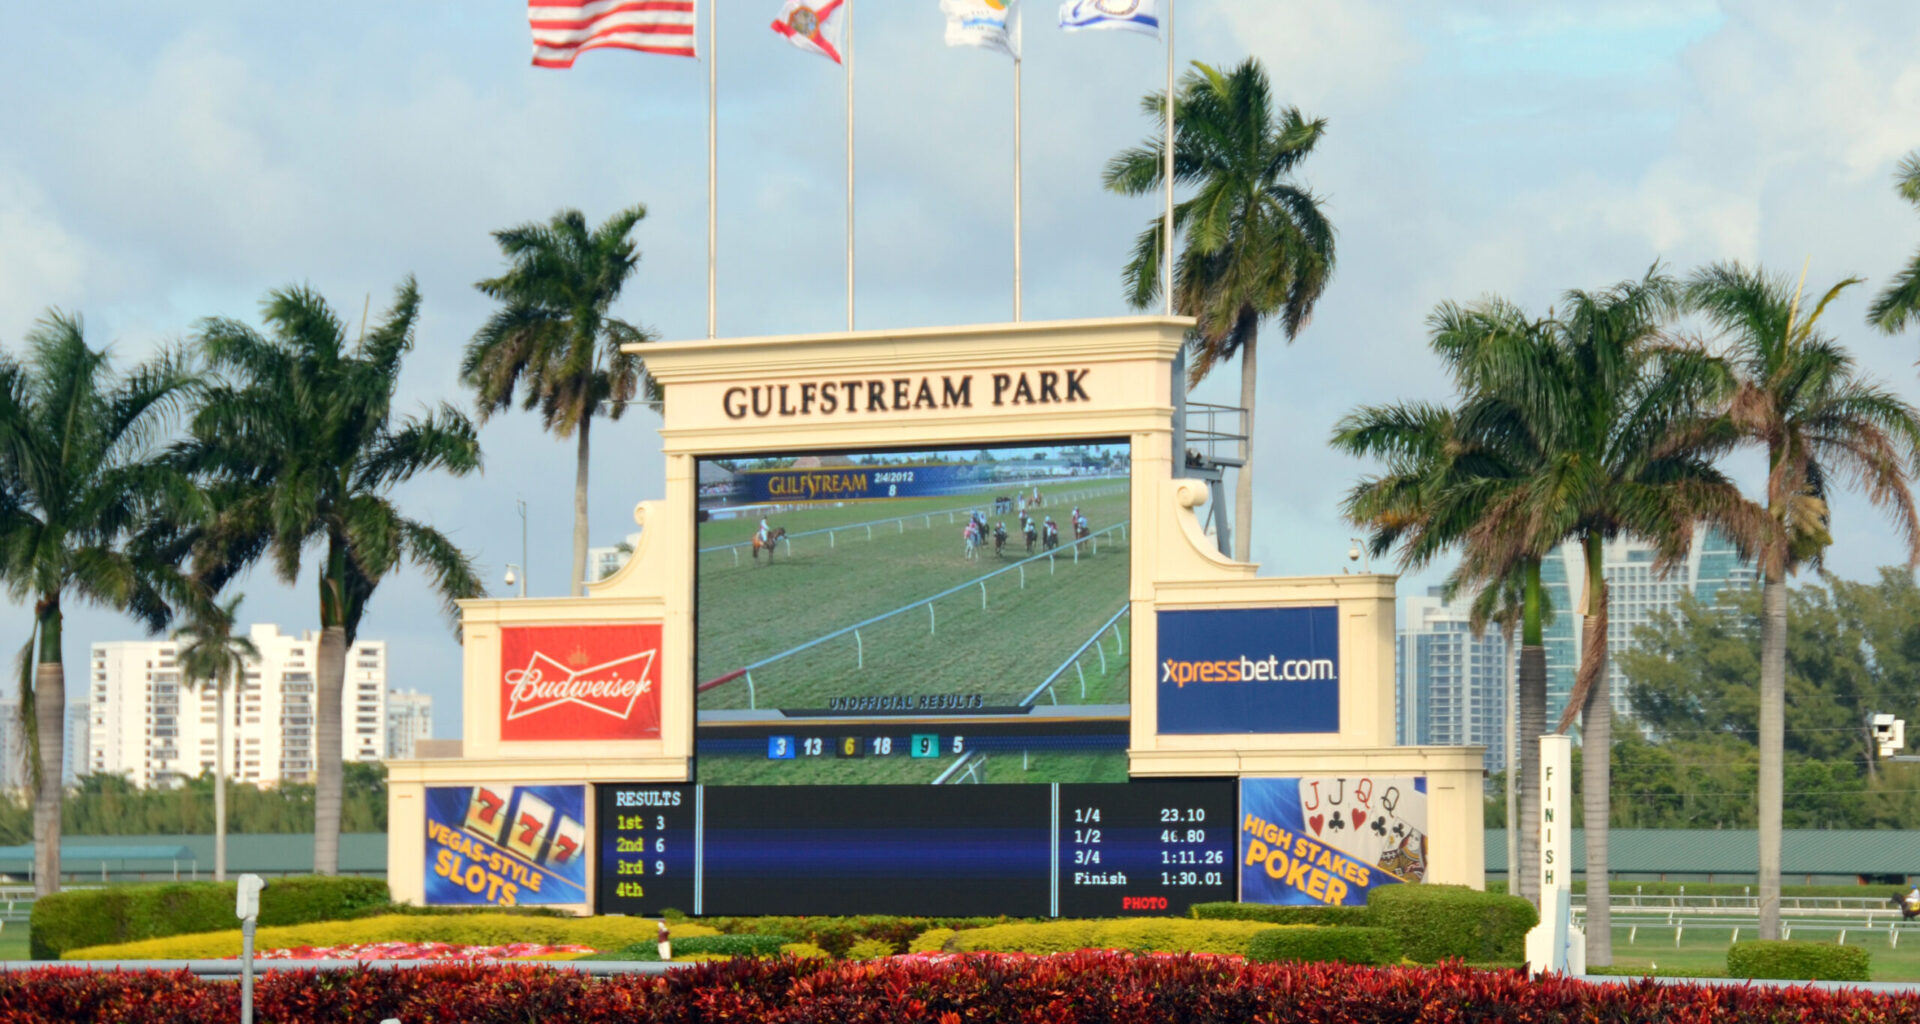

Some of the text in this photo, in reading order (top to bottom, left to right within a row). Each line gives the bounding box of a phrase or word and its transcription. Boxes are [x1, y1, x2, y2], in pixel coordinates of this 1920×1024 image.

[723, 368, 1091, 420] GULFSTREAM PARK
[768, 472, 868, 498] GULFSTREAM
[874, 471, 914, 484] 2/4/2012
[888, 484, 897, 497] 8
[504, 667, 652, 703] Budweiser
[828, 693, 984, 711] UNOFFICIAL RESULTS
[775, 735, 964, 757] 3 13 6 18 9 5
[616, 790, 681, 807] RESULTS
[1305, 781, 1320, 811] J
[1328, 778, 1346, 806] J
[1354, 777, 1373, 810] Q
[1380, 786, 1400, 818] Q
[477, 786, 579, 862] 7 7 7
[618, 814, 665, 830] 1st 3
[1074, 807, 1206, 824] 1/4 23.10
[1544, 766, 1555, 885] FINISH
[616, 836, 665, 852] 2nd 6
[1074, 828, 1206, 845] 1/2 46.80
[428, 818, 543, 893] VEGAS-STYLE
[1074, 849, 1224, 866] 3/4 1:11.26
[1243, 813, 1371, 888] HIGH STAKES
[434, 848, 519, 906] SLOTS
[617, 859, 665, 875] 3rd 9
[1245, 838, 1348, 906] POKER
[616, 881, 644, 897] 4th
[1074, 871, 1223, 886] Finish 1:30.01
[1122, 896, 1168, 910] PHOTO
